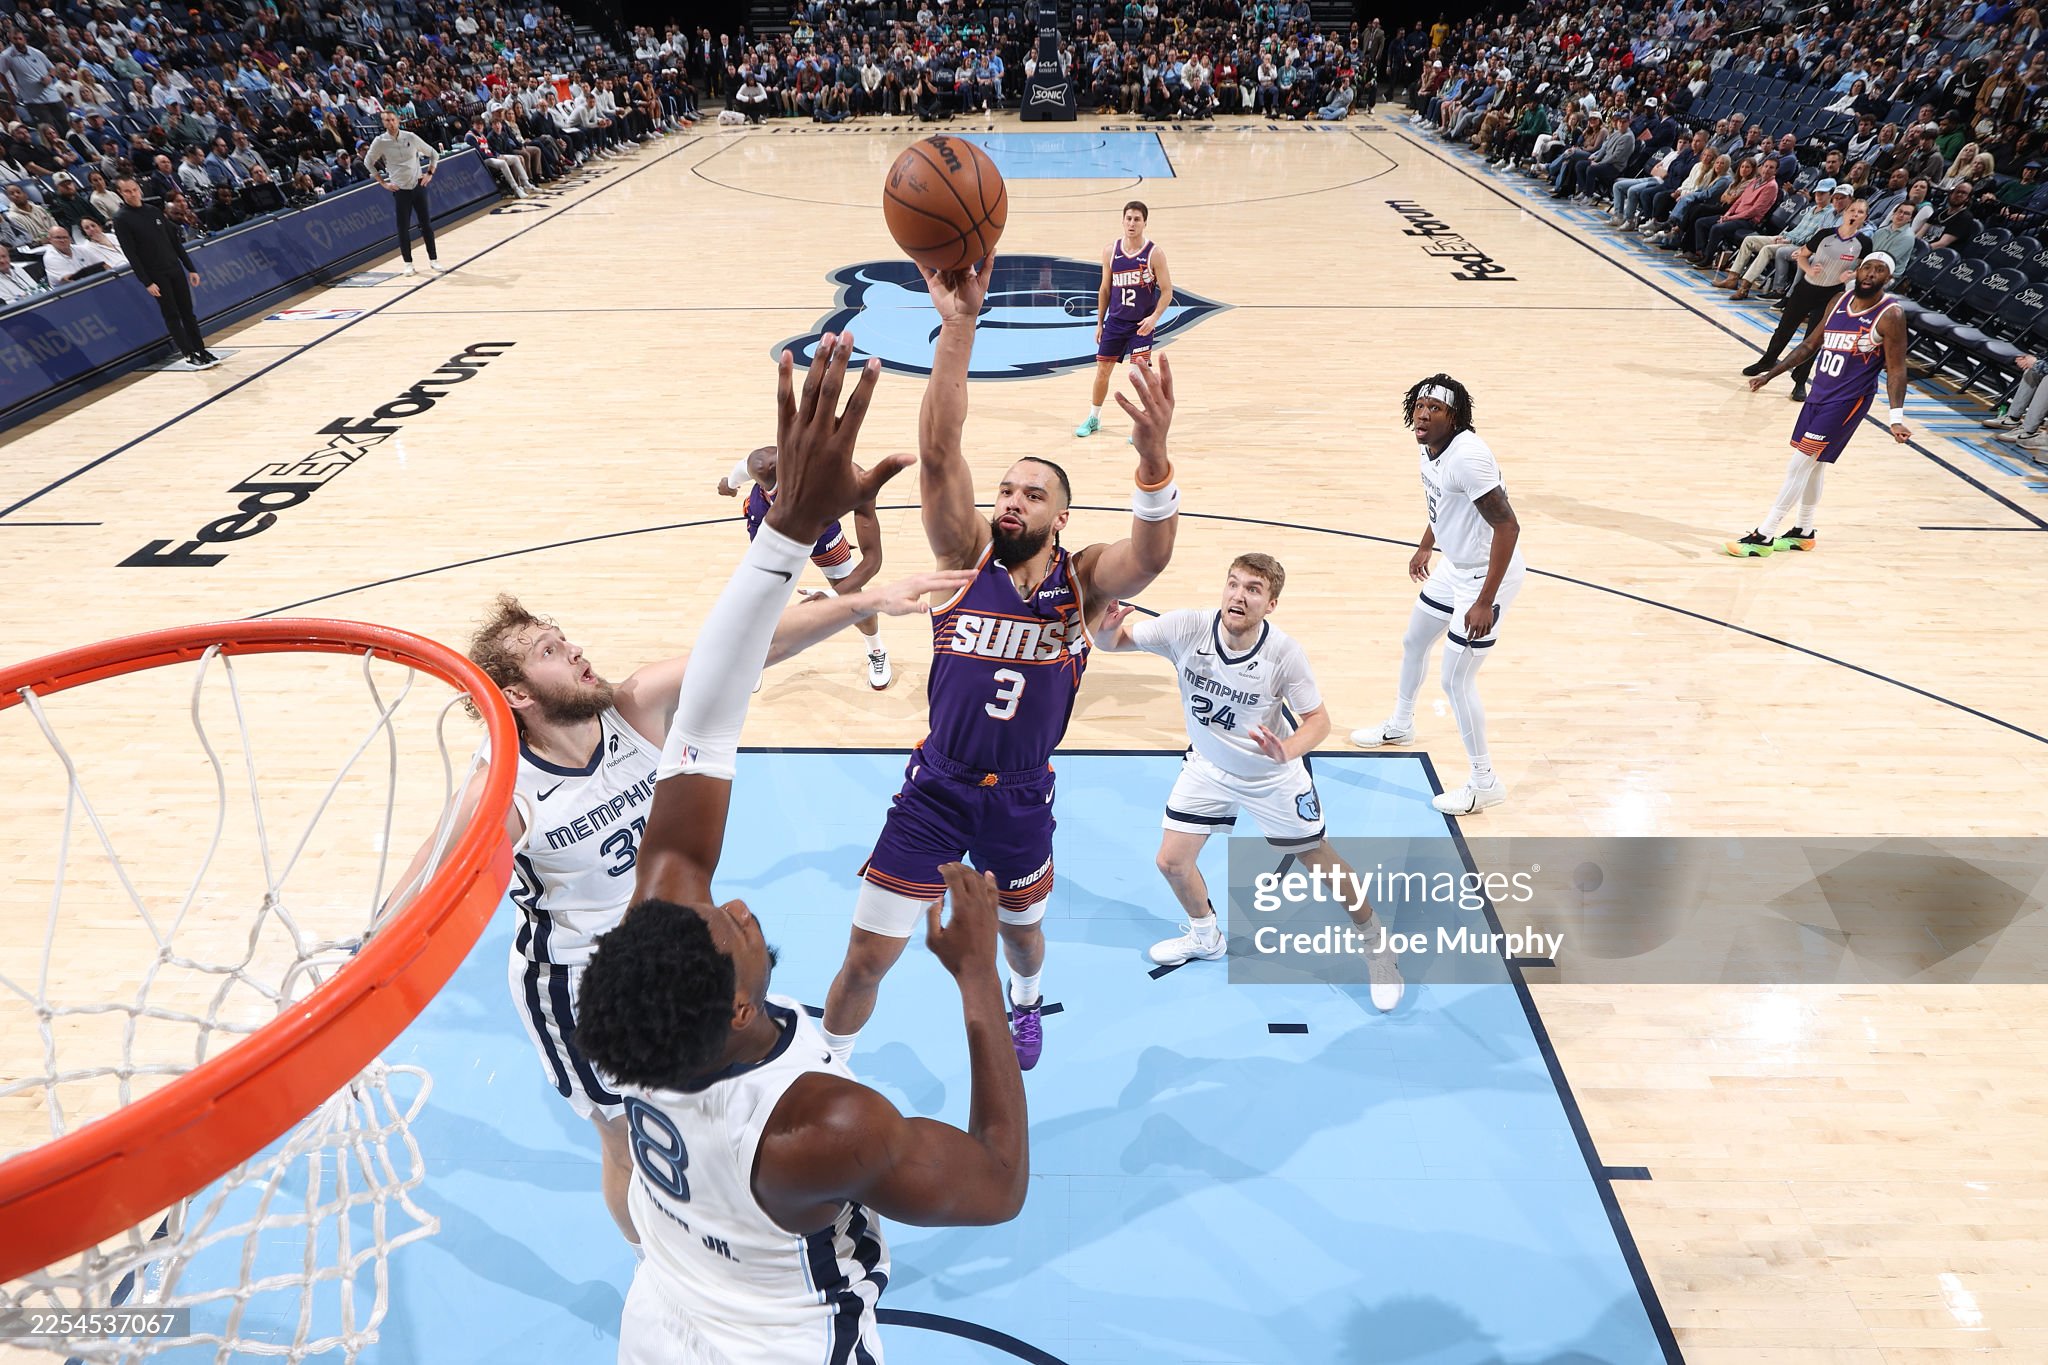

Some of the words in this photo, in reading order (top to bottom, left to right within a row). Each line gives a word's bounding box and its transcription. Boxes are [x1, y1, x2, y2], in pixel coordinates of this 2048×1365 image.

[1035, 91, 1062, 99] SONIC
[771, 125, 995, 134] Robinhood
[430, 171, 476, 198] FANDUEL
[331, 203, 392, 239] FANDUEL
[199, 249, 278, 293] FANDUEL
[1112, 271, 1141, 287] SUNS
[1121, 287, 1136, 307] 12
[1, 314, 119, 374] FANDUEL
[1820, 349, 1845, 377] 00
[1038, 586, 1070, 600] PayPal
[950, 614, 1066, 661] SUNS
[984, 667, 1027, 721] 3
[1184, 667, 1261, 706] MEMPHIS
[1190, 693, 1236, 731] 24
[606, 748, 639, 770] Robinhood
[623, 1096, 690, 1204] 8
